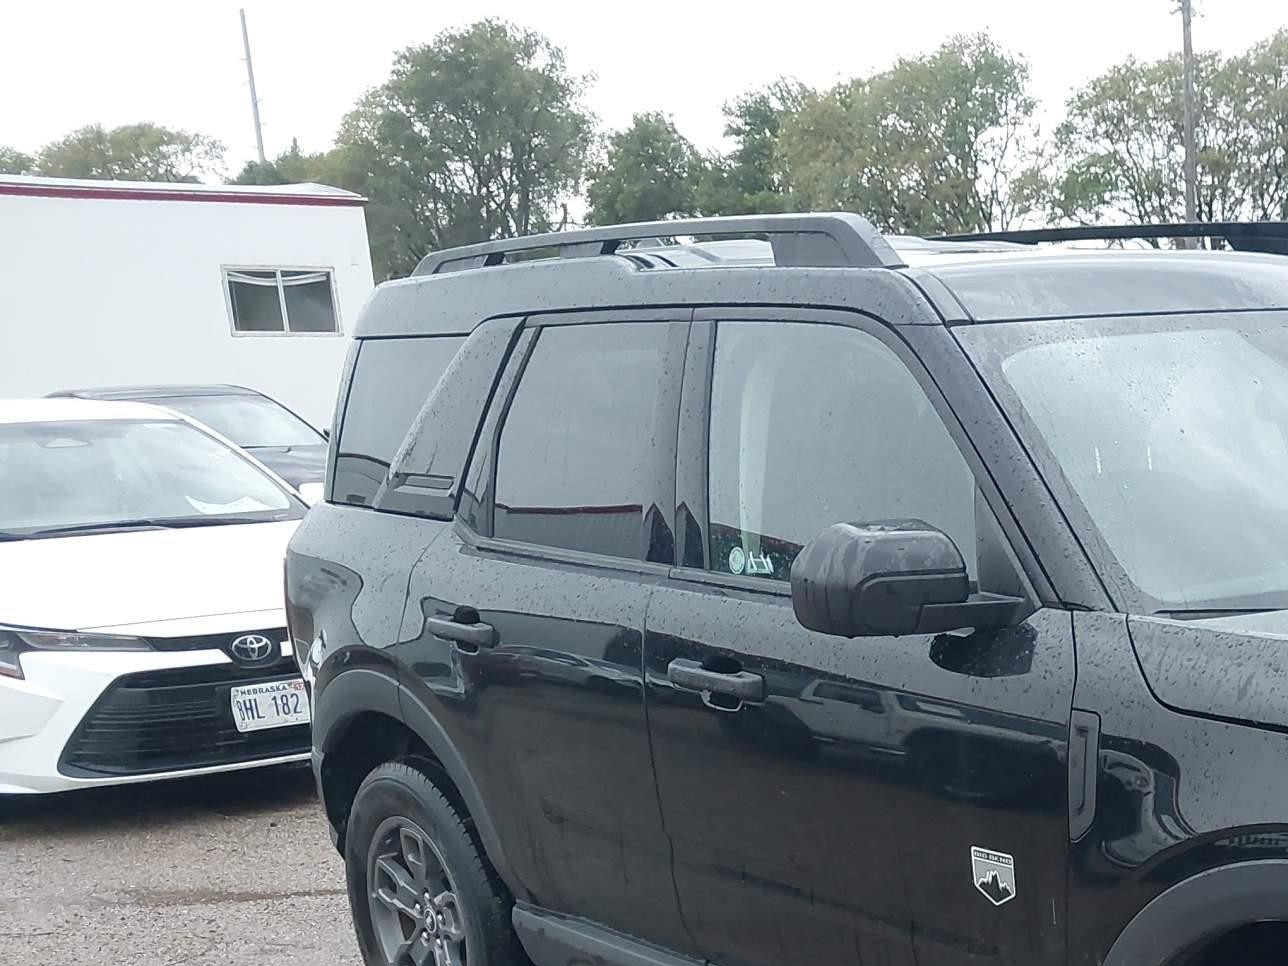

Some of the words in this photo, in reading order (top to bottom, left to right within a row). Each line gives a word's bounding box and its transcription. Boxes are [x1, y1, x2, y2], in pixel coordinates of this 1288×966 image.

[240, 684, 288, 696] NEBRASKA
[236, 698, 265, 721] BHL
[272, 693, 302, 716] 182
